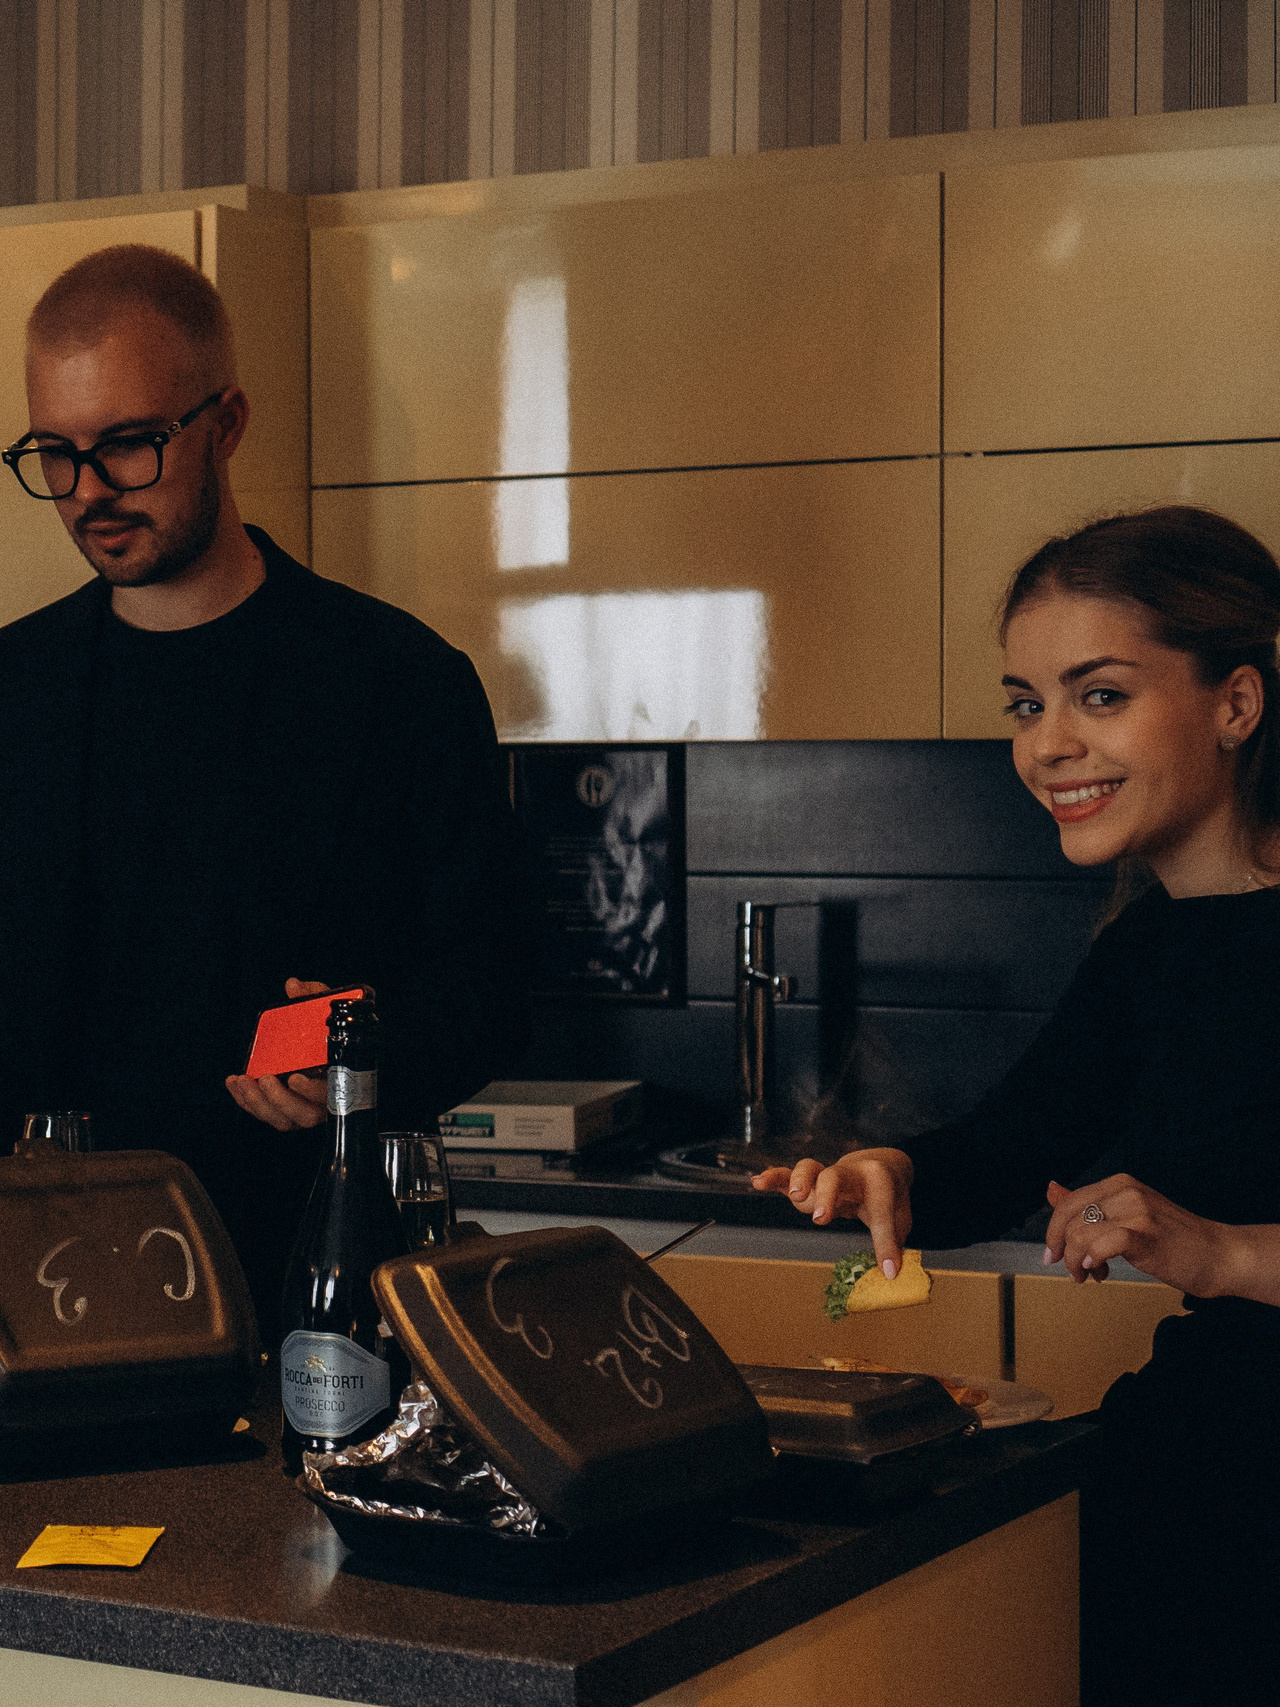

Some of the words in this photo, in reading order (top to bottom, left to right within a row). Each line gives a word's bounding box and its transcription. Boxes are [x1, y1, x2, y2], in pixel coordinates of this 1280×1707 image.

[285, 1367, 313, 1386] ROCCA
[323, 1375, 364, 1389] FORTI
[294, 1395, 346, 1413] PROSECCO
